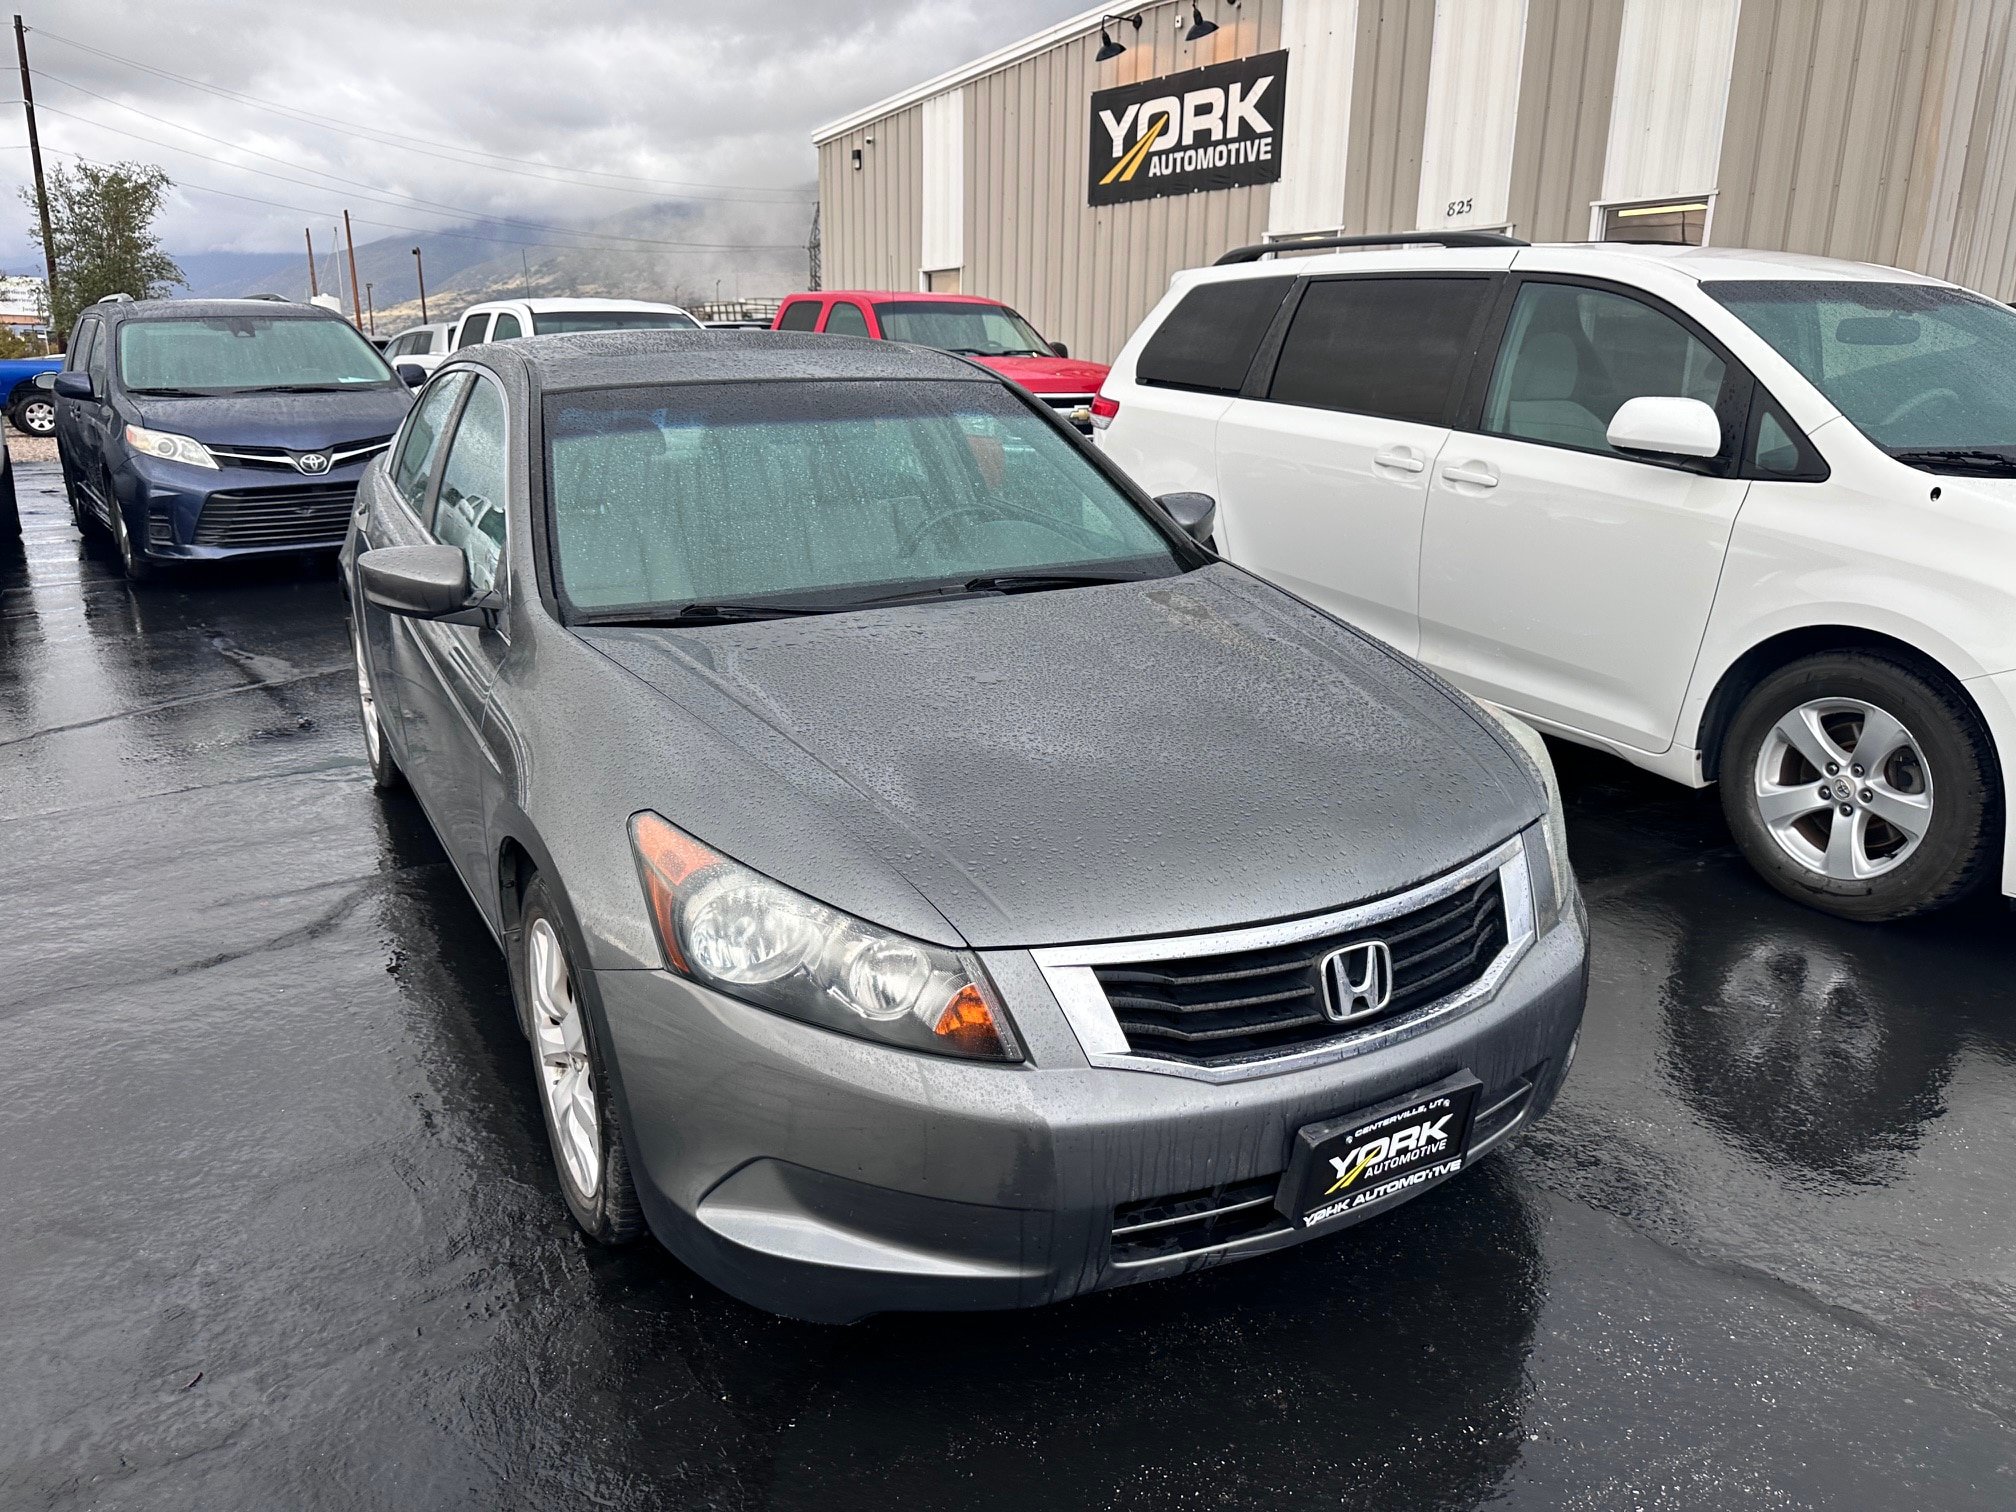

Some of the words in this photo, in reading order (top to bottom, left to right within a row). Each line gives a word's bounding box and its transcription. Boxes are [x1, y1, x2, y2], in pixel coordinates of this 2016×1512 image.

[1099, 76, 1274, 158] YORK
[1149, 137, 1272, 177] AUTOMOTIVE
[1447, 198, 1473, 217] 825
[1429, 1099, 1444, 1109] UT
[1329, 1113, 1454, 1179] YORK
[1364, 1139, 1447, 1179] AUTOMOTIVE
[1352, 1159, 1462, 1207] AUTOMOTIVE
